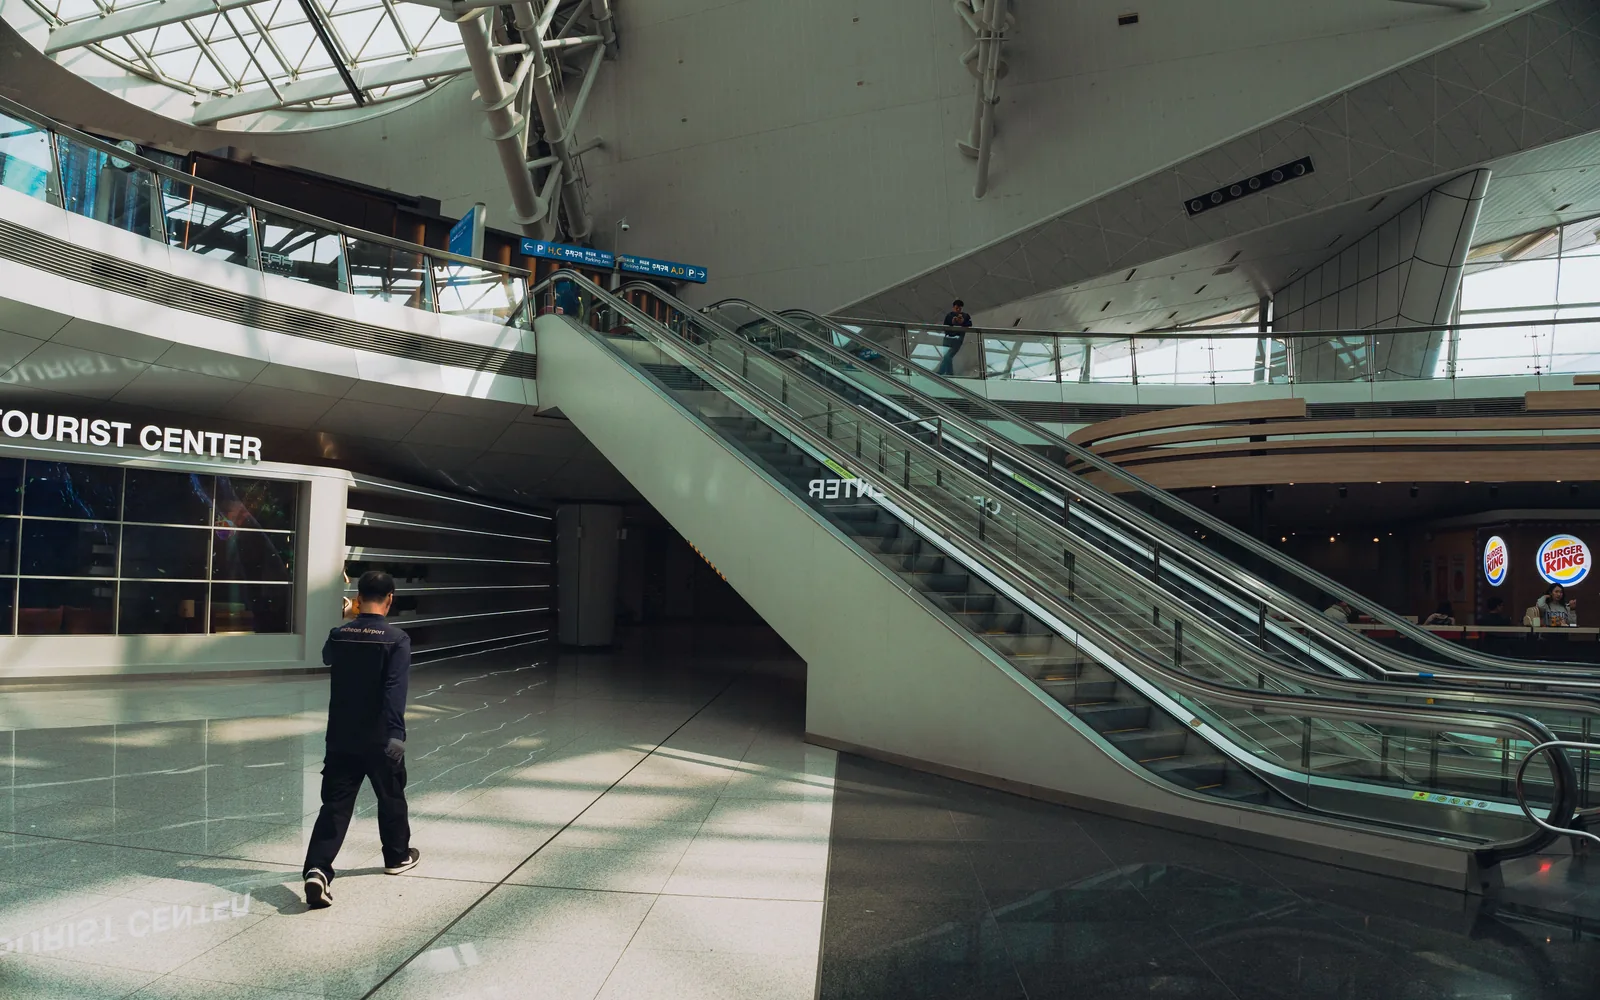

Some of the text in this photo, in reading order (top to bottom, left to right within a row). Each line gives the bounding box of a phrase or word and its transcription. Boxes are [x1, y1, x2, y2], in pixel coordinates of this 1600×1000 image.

[536, 244, 544, 252] P
[585, 256, 601, 264] Parking
[623, 262, 639, 270] Parking
[688, 269, 695, 277] P
[0, 409, 262, 461] OURIST CENTER
[1486, 545, 1503, 563] BURGER
[1543, 544, 1583, 562] BURGER
[1487, 553, 1504, 575] KING
[1545, 553, 1585, 575] KING
